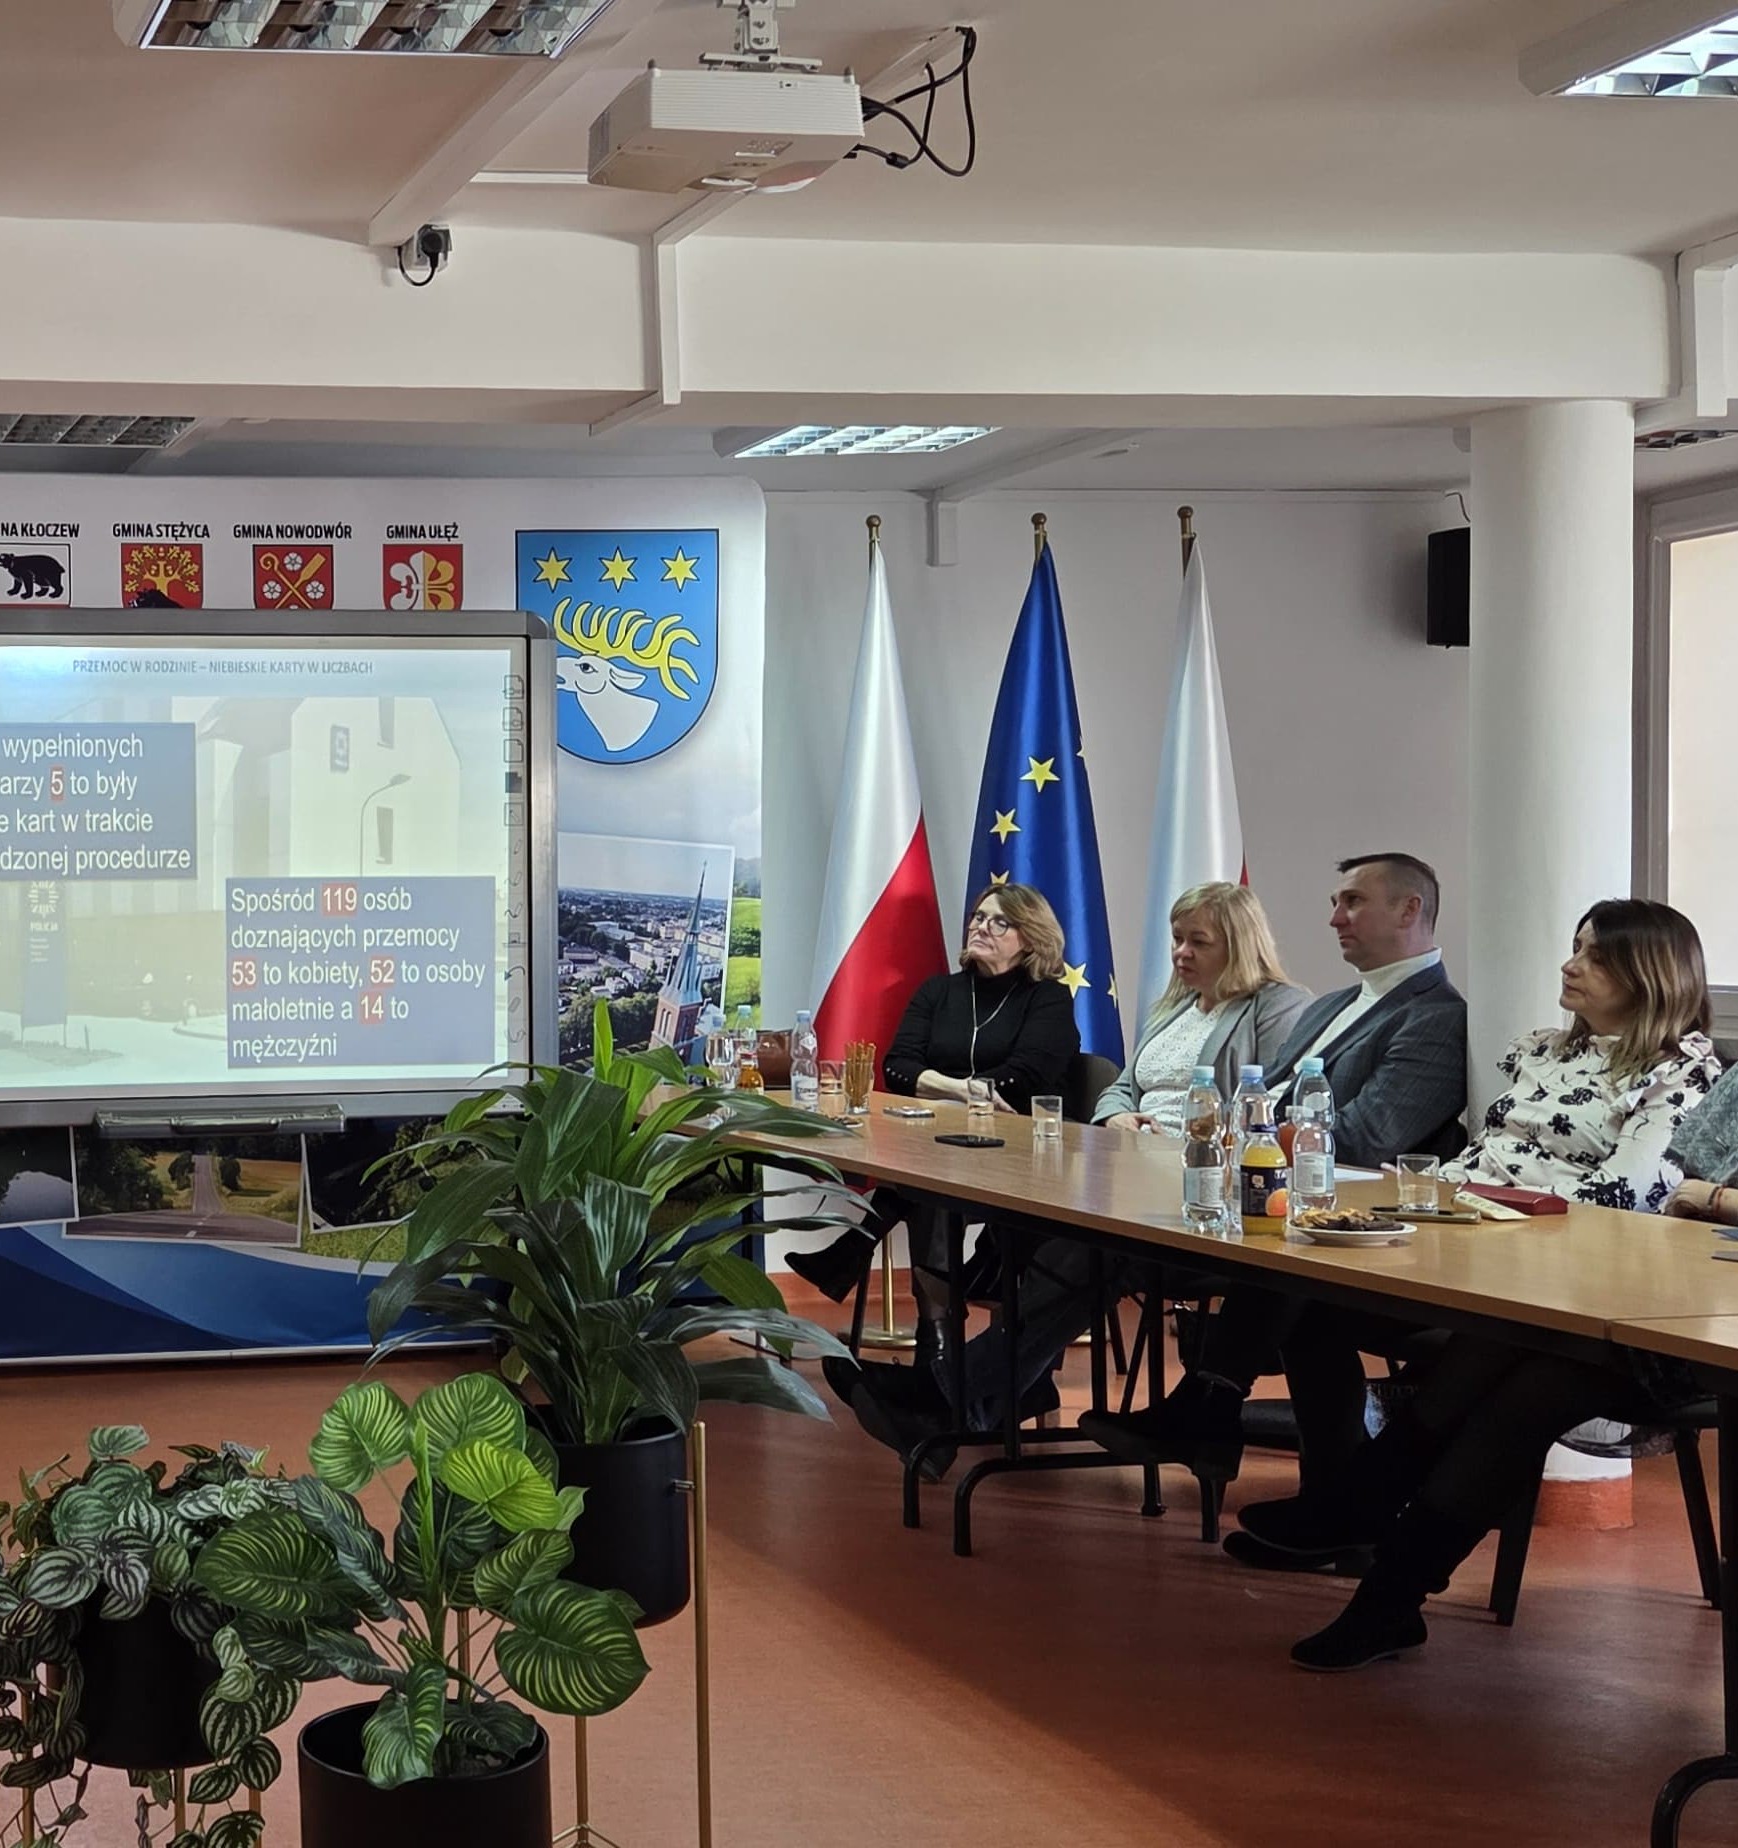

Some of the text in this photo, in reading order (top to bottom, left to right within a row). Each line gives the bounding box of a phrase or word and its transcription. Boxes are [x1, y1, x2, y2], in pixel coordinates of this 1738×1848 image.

[20, 522, 80, 538] KŁOCZEW
[113, 522, 210, 541] GMINA STĘŻYCA
[233, 521, 352, 539] GMINA NOWODWÓR
[387, 522, 459, 541] GMINA UŁĘŻ
[73, 660, 127, 673] PRZEMOC
[130, 660, 142, 673] W
[145, 661, 197, 673] RODZINIE
[209, 661, 267, 673] NIEBIESKIE
[270, 661, 304, 673] KARTY
[307, 661, 319, 673] W
[322, 661, 373, 674] LICZBACH
[2, 732, 143, 763] wypełnionych
[51, 771, 63, 795] 5
[70, 774, 89, 795] to
[97, 769, 137, 800] były
[16, 808, 55, 833] kart
[61, 813, 79, 833] w
[85, 807, 153, 833] trakcie
[76, 844, 191, 876] procedurze
[231, 887, 412, 917] Spośród 119 osób
[231, 924, 460, 954] doznających przemocy
[232, 958, 486, 989] 53 to kobiety, 52 to osoby
[232, 996, 409, 1022] małoletnie a 14 to
[233, 1032, 337, 1063] mężczyźni
